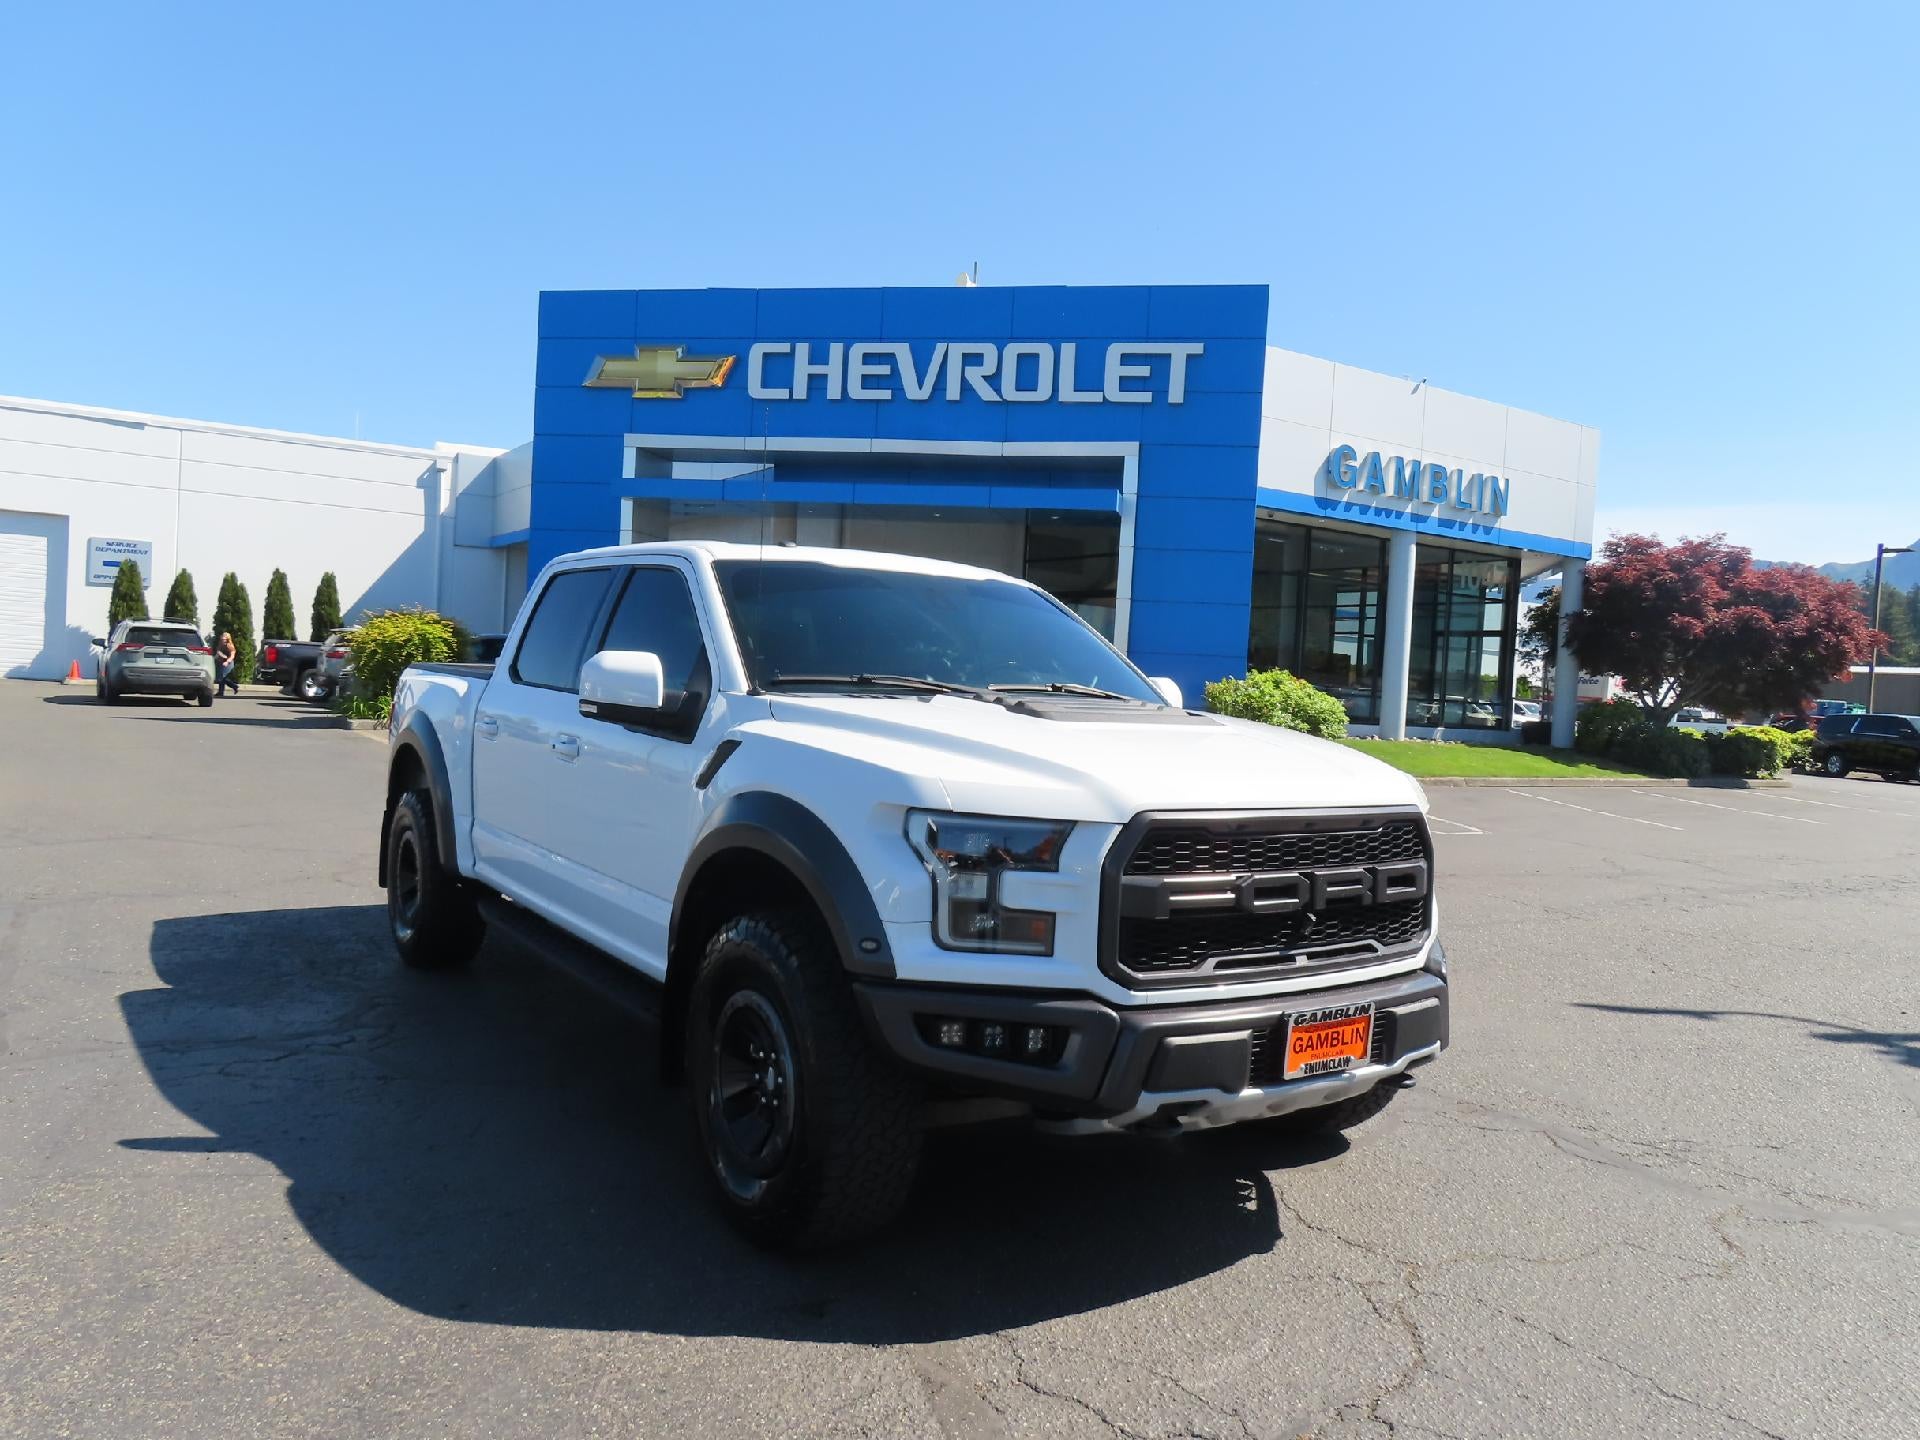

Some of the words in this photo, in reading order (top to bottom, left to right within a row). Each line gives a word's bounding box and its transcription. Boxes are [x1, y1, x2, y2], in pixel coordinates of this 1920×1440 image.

[748, 342, 1205, 404] CHEVROLET
[1329, 444, 1510, 516] GAMBLIN
[95, 546, 149, 555] DEPARTMENT
[1120, 860, 1428, 919] FORD
[1293, 1003, 1372, 1026] GAMBLIN
[1292, 1026, 1366, 1055] GAMBLIN
[1304, 1056, 1351, 1075] ENUMCLAW
